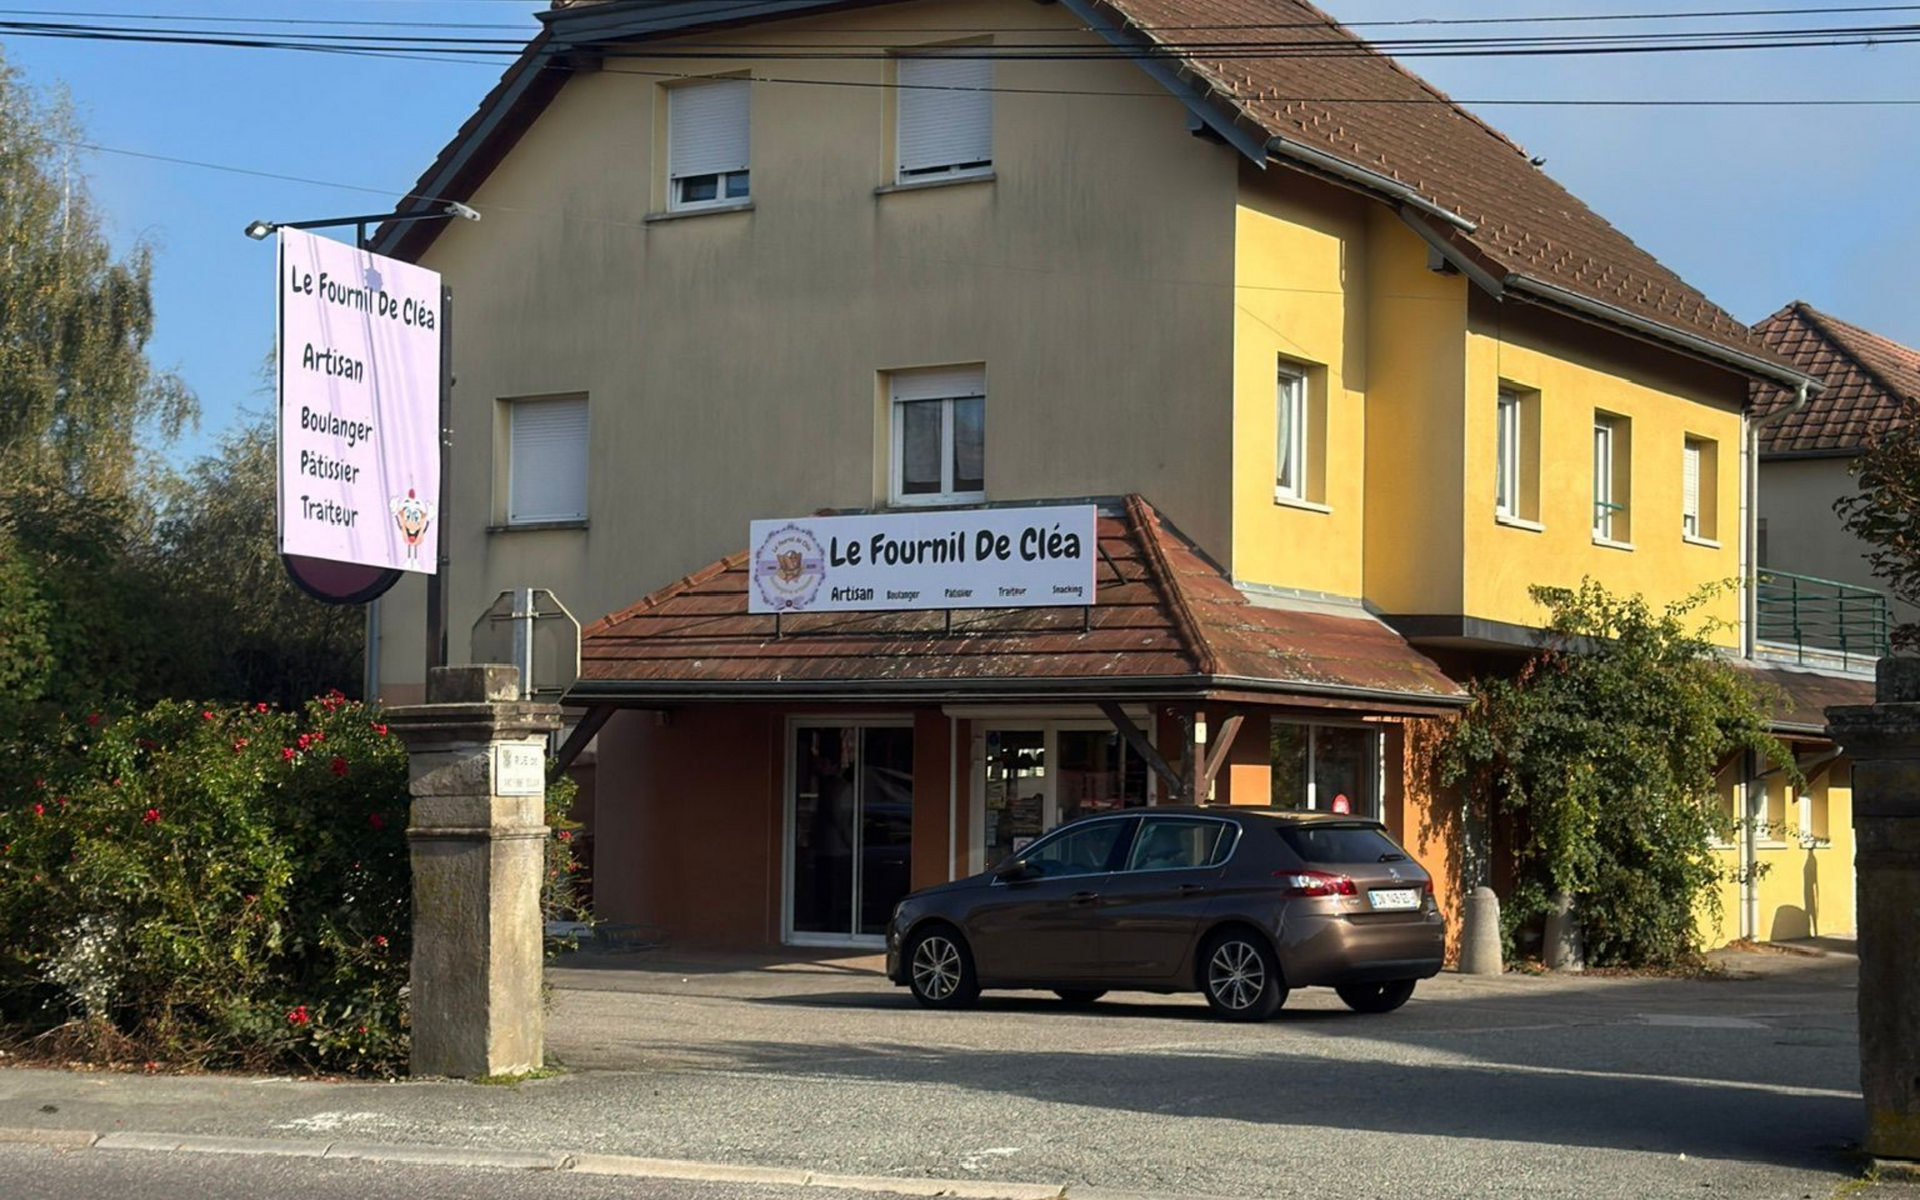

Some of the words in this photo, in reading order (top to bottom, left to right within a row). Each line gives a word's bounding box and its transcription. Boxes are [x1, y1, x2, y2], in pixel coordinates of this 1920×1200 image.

[292, 264, 313, 295] Le
[319, 272, 373, 314] Fournil
[378, 290, 398, 320] De
[403, 297, 435, 331] Cléa
[303, 342, 363, 384] Artisan
[301, 405, 373, 447] Boulanger
[300, 449, 360, 484] Pâtissier
[300, 495, 359, 528] Traiteur
[830, 536, 861, 567] Le
[870, 531, 965, 566] Fournil
[976, 529, 1011, 562] De
[1019, 522, 1081, 562] Cléa
[831, 586, 874, 601] Artisan
[886, 590, 921, 602] Boulanger
[998, 586, 1027, 597] Traiteur
[1052, 584, 1083, 597] Snacking
